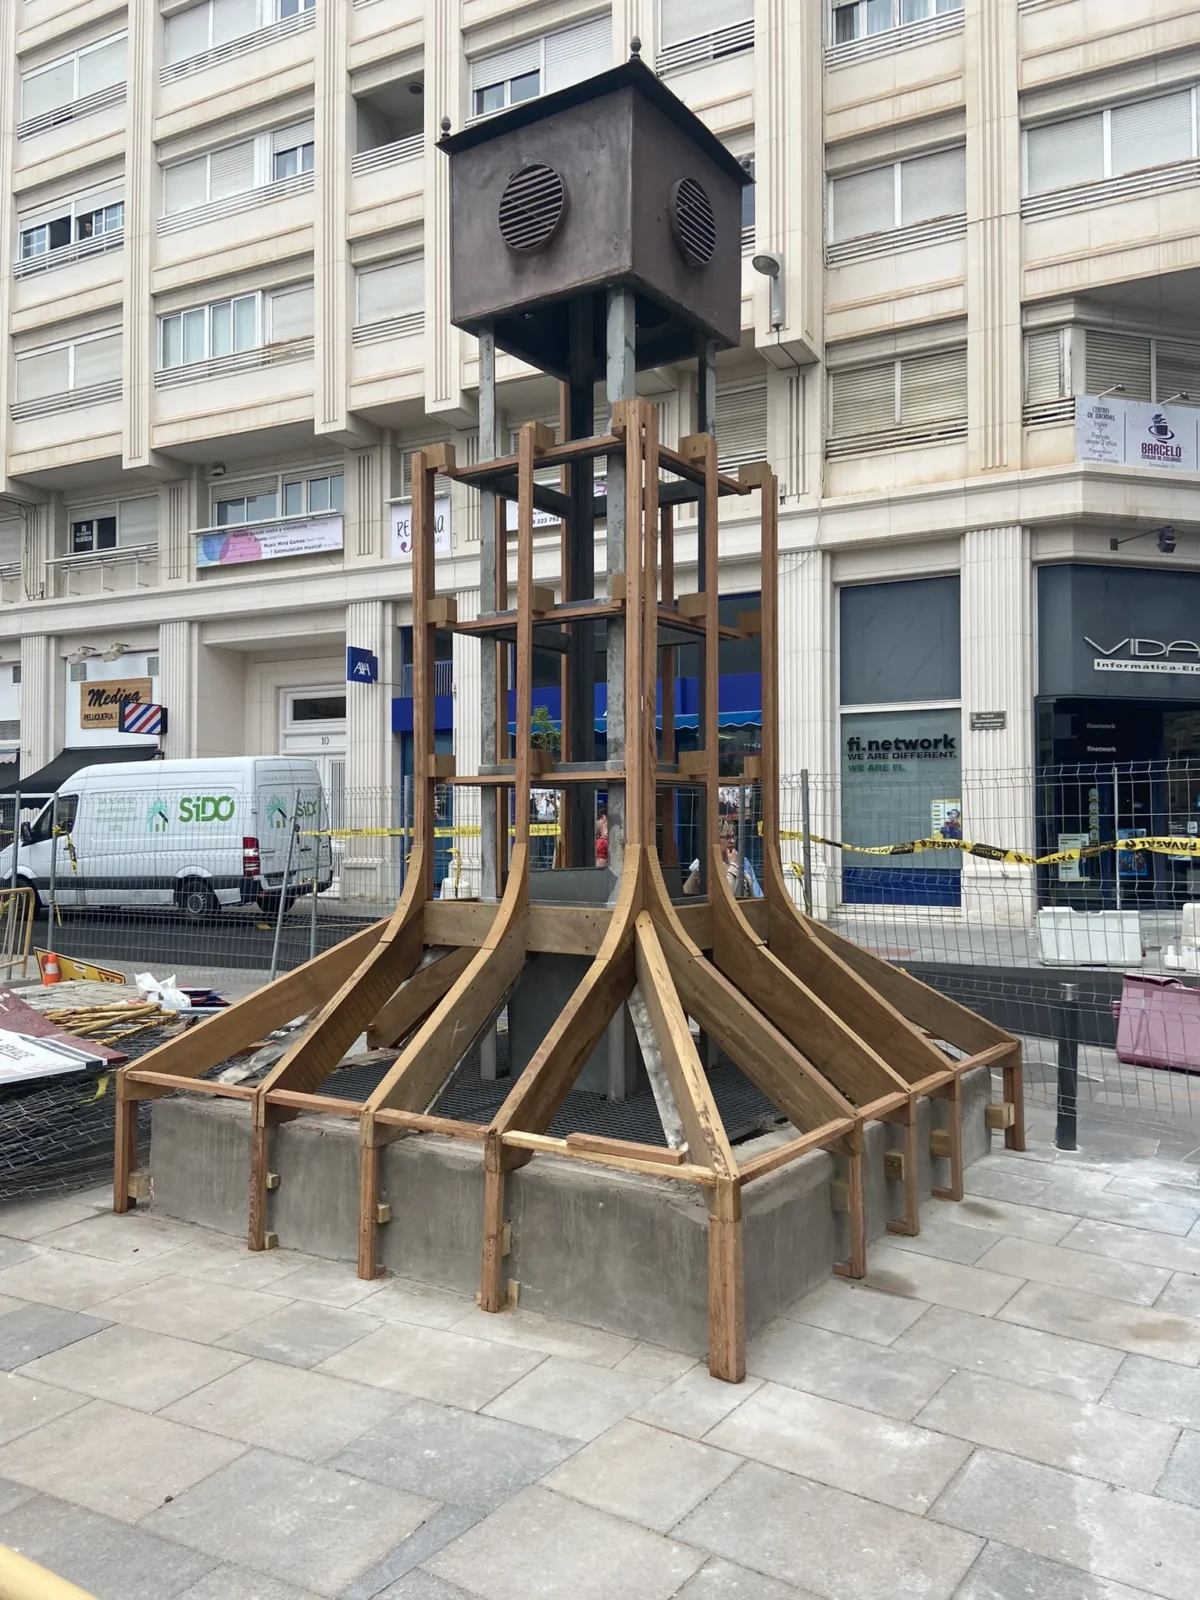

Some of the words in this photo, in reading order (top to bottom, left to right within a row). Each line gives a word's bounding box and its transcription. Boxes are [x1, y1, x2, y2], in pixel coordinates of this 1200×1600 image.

[1141, 443, 1182, 458] BARCELÓ
[274, 546, 303, 554] Estimulación
[353, 661, 371, 676] AXA
[88, 688, 141, 707] Medina
[892, 751, 957, 759] DIFFERENT,
[867, 764, 889, 772] ARE
[1139, 840, 1197, 851] PAVASAL
